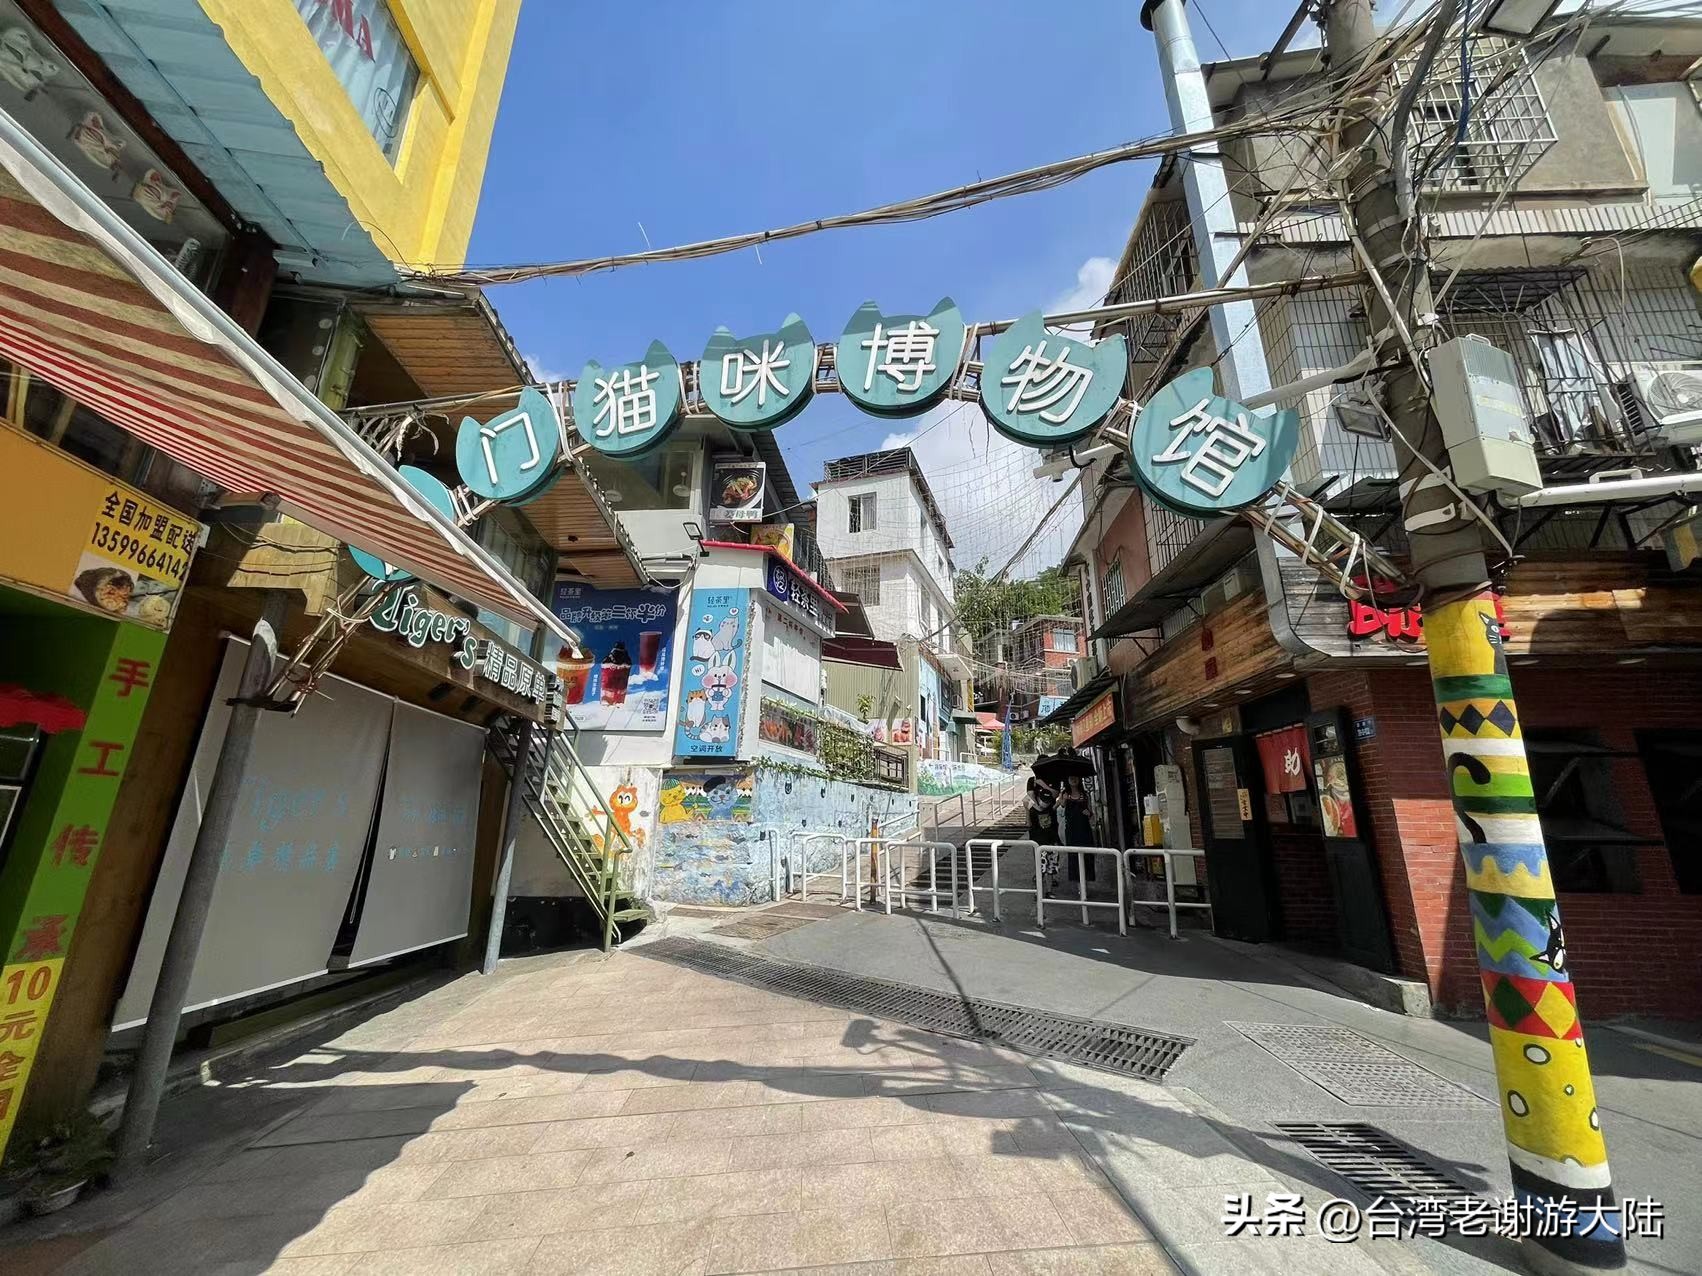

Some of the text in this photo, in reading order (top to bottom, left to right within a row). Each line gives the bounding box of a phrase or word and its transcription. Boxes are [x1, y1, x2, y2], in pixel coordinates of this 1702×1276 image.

[101, 490, 197, 556] 全国加盟配送
[560, 603, 667, 624] 品牌升级第二杯半价
[482, 642, 546, 705] 精品原单
[690, 744, 723, 753] 空调开放
[1284, 747, 1301, 776] 助
